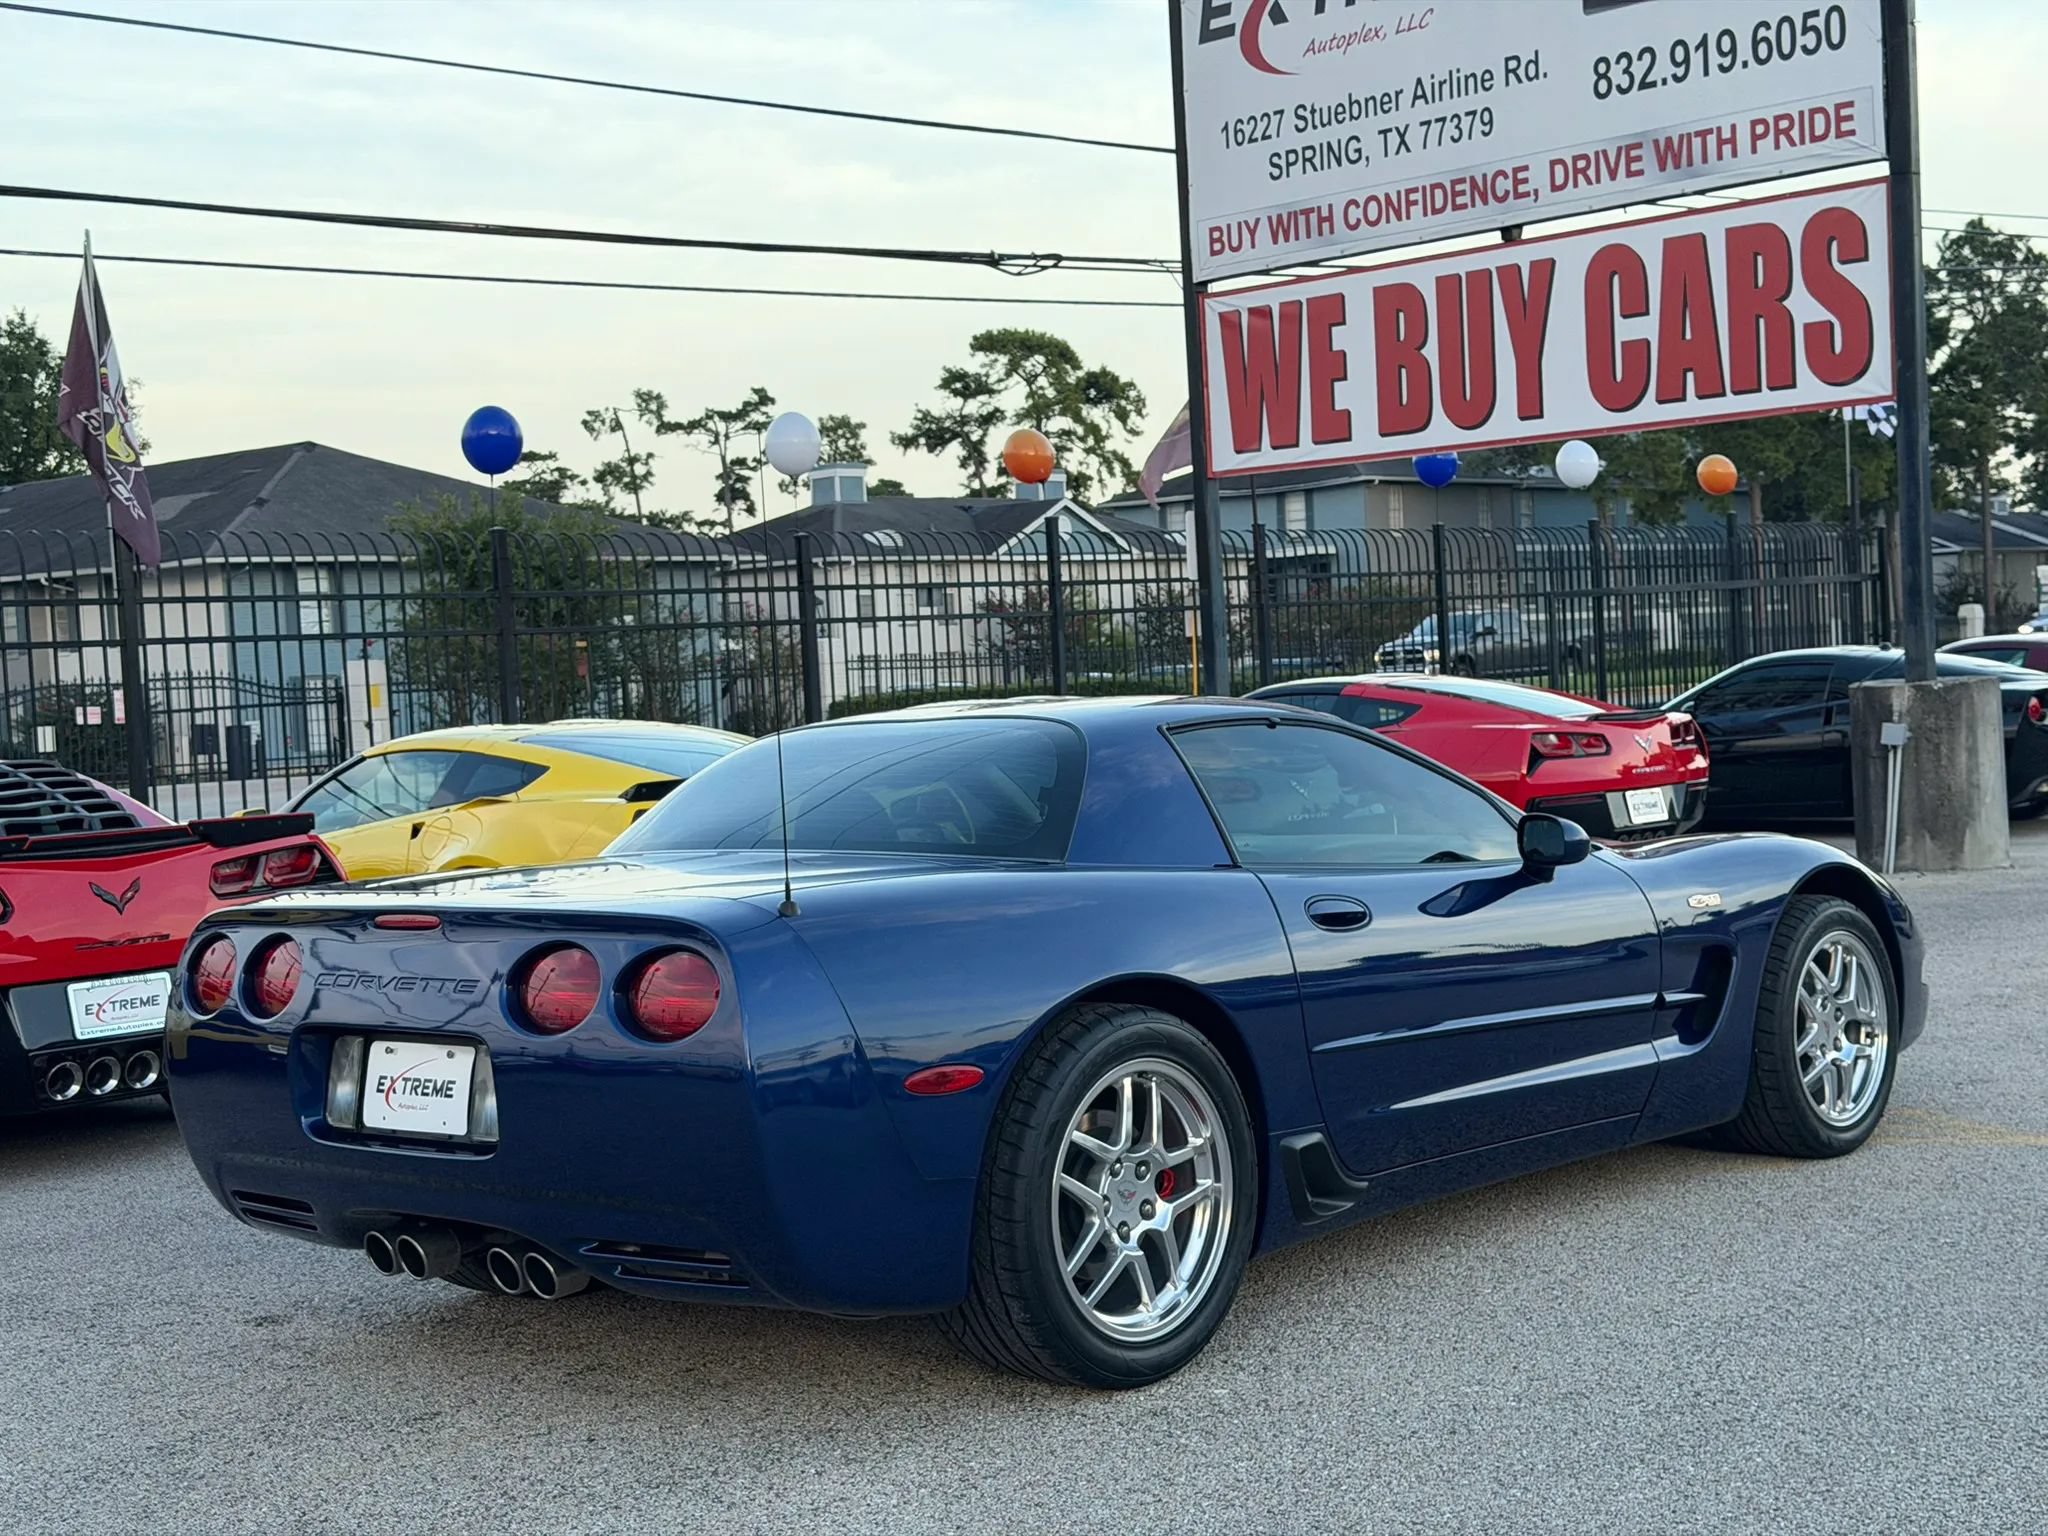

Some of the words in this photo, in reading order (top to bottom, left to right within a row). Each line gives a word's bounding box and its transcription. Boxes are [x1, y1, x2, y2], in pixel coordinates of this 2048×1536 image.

[1302, 23, 1387, 58] Autoplex,
[1394, 8, 1435, 35] LLC
[1592, 4, 1847, 101] 832.919.6050
[1220, 109, 1286, 150] 16227
[1293, 89, 1404, 133] Stuebner
[1410, 66, 1495, 109] Airline
[1503, 50, 1549, 88] Rd.
[1208, 217, 1261, 257] BUY
[1267, 203, 1335, 246] WITH
[1343, 164, 1539, 231] CONFIDENCE,
[1549, 142, 1645, 193] DRIVE
[1652, 123, 1739, 173] WITH
[1749, 101, 1857, 155] PRIDE
[1268, 134, 1371, 182] SPRING,
[1377, 123, 1412, 159] TX
[1418, 106, 1495, 149] 77379
[1219, 292, 1353, 455] WE
[1373, 256, 1557, 438] BUY
[1584, 206, 1874, 413] CARS
[84, 994, 161, 1017] EXTREME
[313, 972, 481, 995] CORVETTE
[375, 1074, 457, 1099] EXTREME
